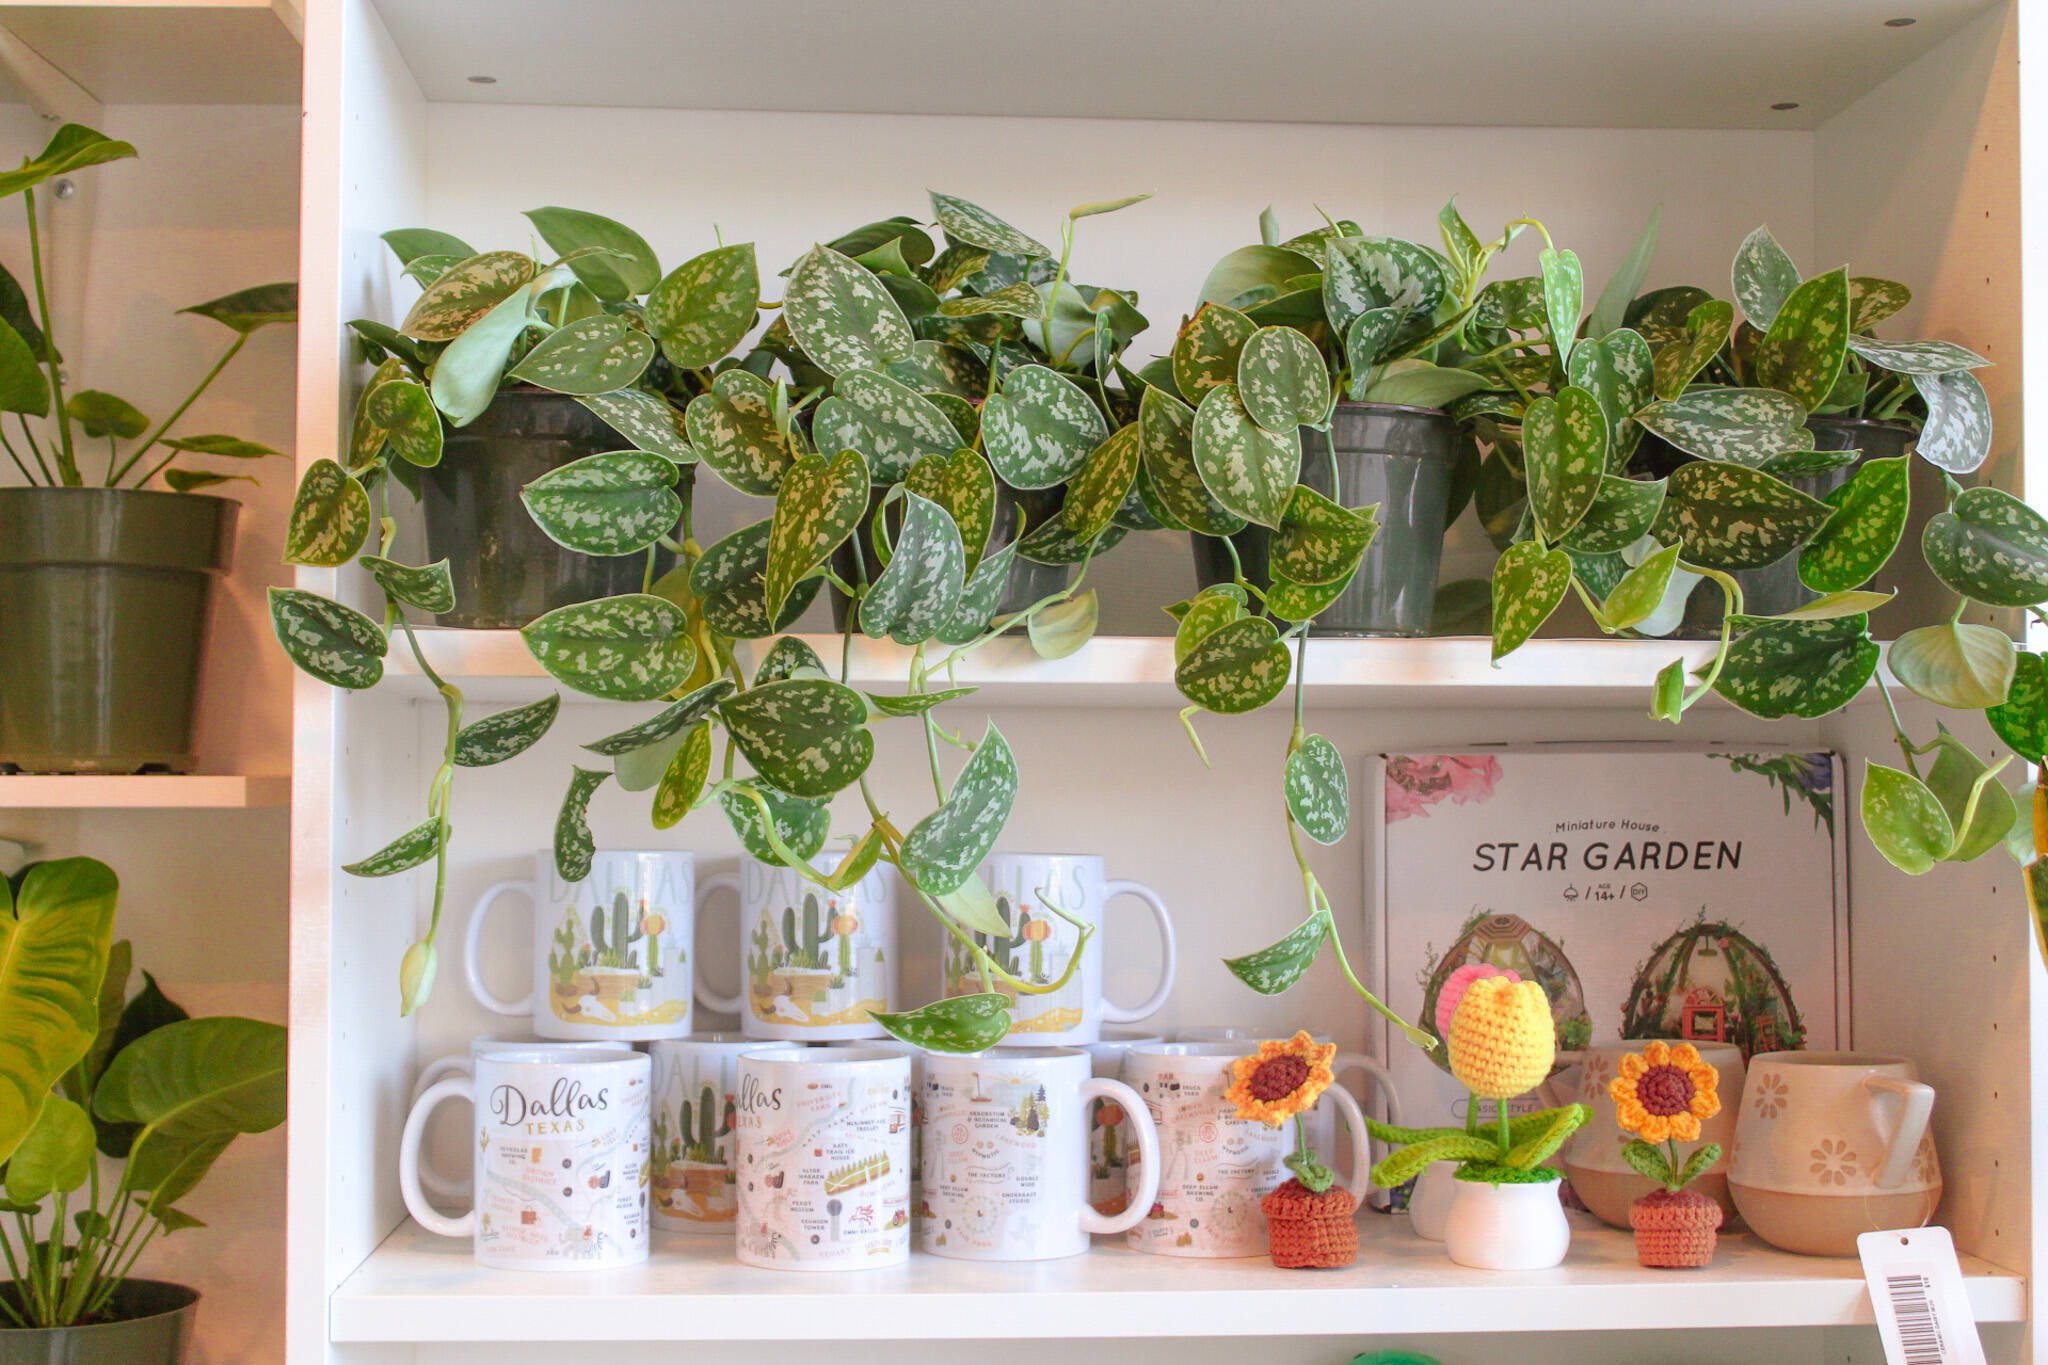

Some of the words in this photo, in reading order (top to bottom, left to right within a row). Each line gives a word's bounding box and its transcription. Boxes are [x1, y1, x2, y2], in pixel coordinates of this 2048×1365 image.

[1555, 819, 1616, 832] Miniature
[1620, 819, 1661, 832] House
[1472, 842, 1568, 872] STAR
[1583, 841, 1742, 871] GARDEN
[747, 859, 887, 904] DALLS
[490, 1077, 609, 1127] Dallas
[526, 1119, 585, 1136] TEXAS
[737, 1116, 762, 1129] EXAS
